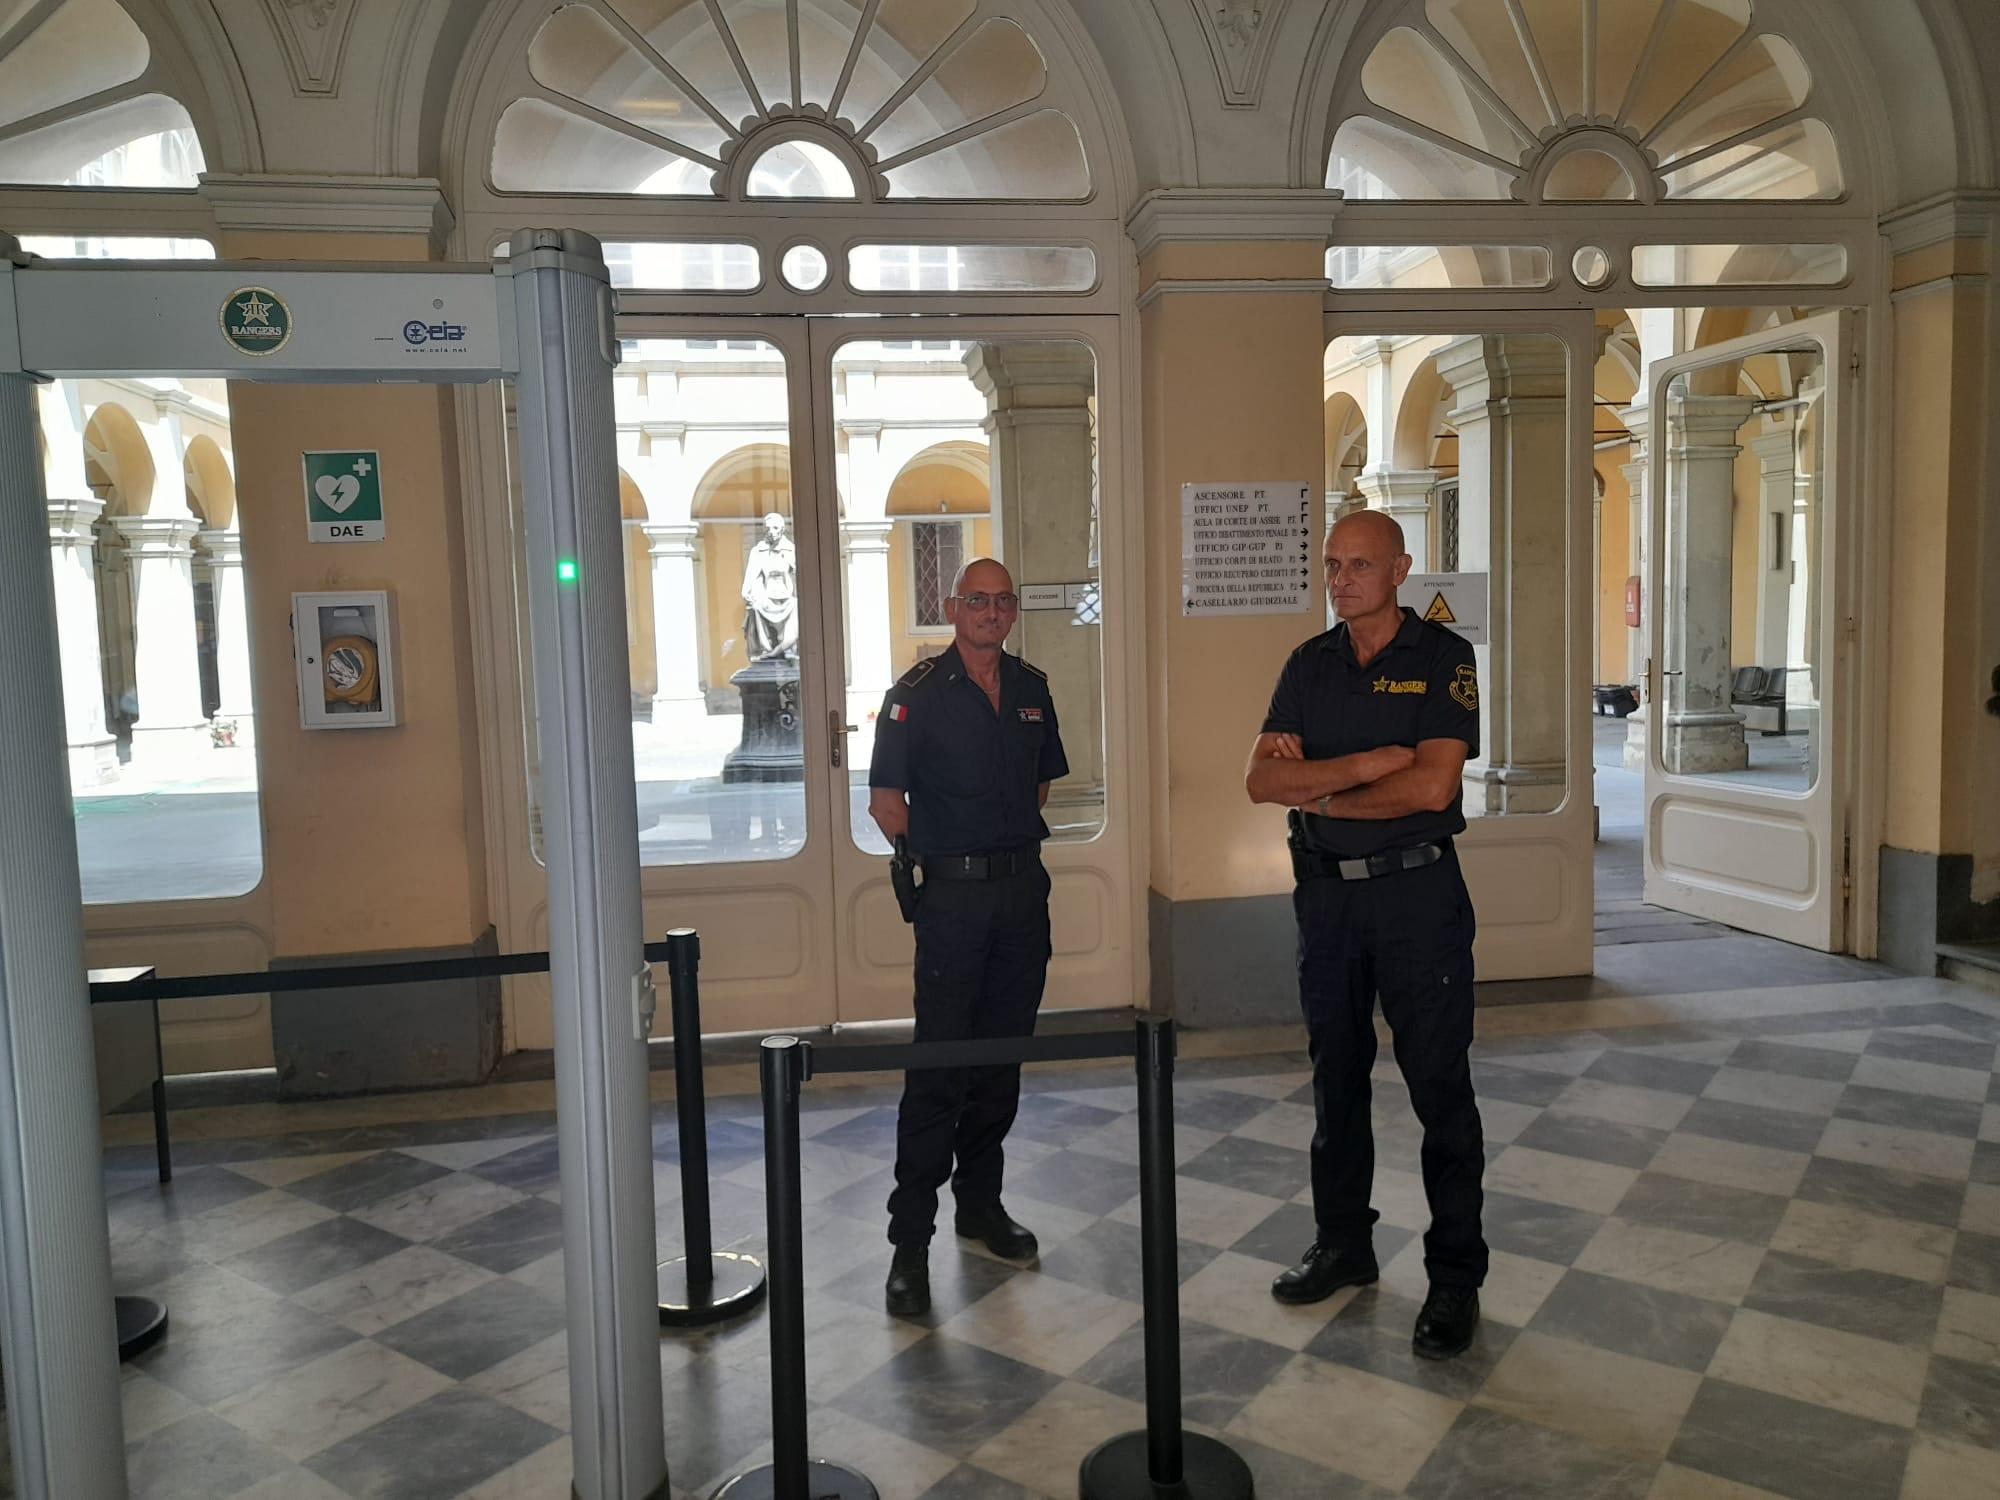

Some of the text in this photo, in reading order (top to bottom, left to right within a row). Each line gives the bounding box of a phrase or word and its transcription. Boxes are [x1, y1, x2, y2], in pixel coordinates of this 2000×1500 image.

[231, 326, 282, 335] RANGERS
[1195, 491, 1246, 500] ASCENSORE
[1194, 505, 1222, 514] UFFICI
[1226, 504, 1249, 513] UNEP
[1194, 518, 1213, 527] AULA
[1215, 518, 1223, 526] DI
[1223, 517, 1248, 526] CORTE
[1250, 517, 1257, 525] DI
[1260, 516, 1281, 525] ASSISE
[330, 525, 364, 537] DAE
[1193, 531, 1218, 539] UFFICIO
[1219, 530, 1265, 538] DIBATTIMENTO
[1265, 529, 1289, 537] PENALE
[1195, 544, 1229, 552] UFFICIO
[1195, 557, 1223, 565] UFFICIO
[1224, 556, 1247, 565] CORPI
[1248, 556, 1256, 564] DI
[1258, 555, 1283, 564] REATO
[1195, 571, 1222, 579] UFFICIO
[1223, 570, 1259, 579] RECUPERO
[1260, 569, 1288, 577] CREDITI
[1196, 585, 1225, 593] PROCURA
[1226, 584, 1247, 593] DELLA
[1248, 583, 1284, 592] REPUBBLICA
[1195, 596, 1298, 608] CASELLARIO GIUDIZIALE
